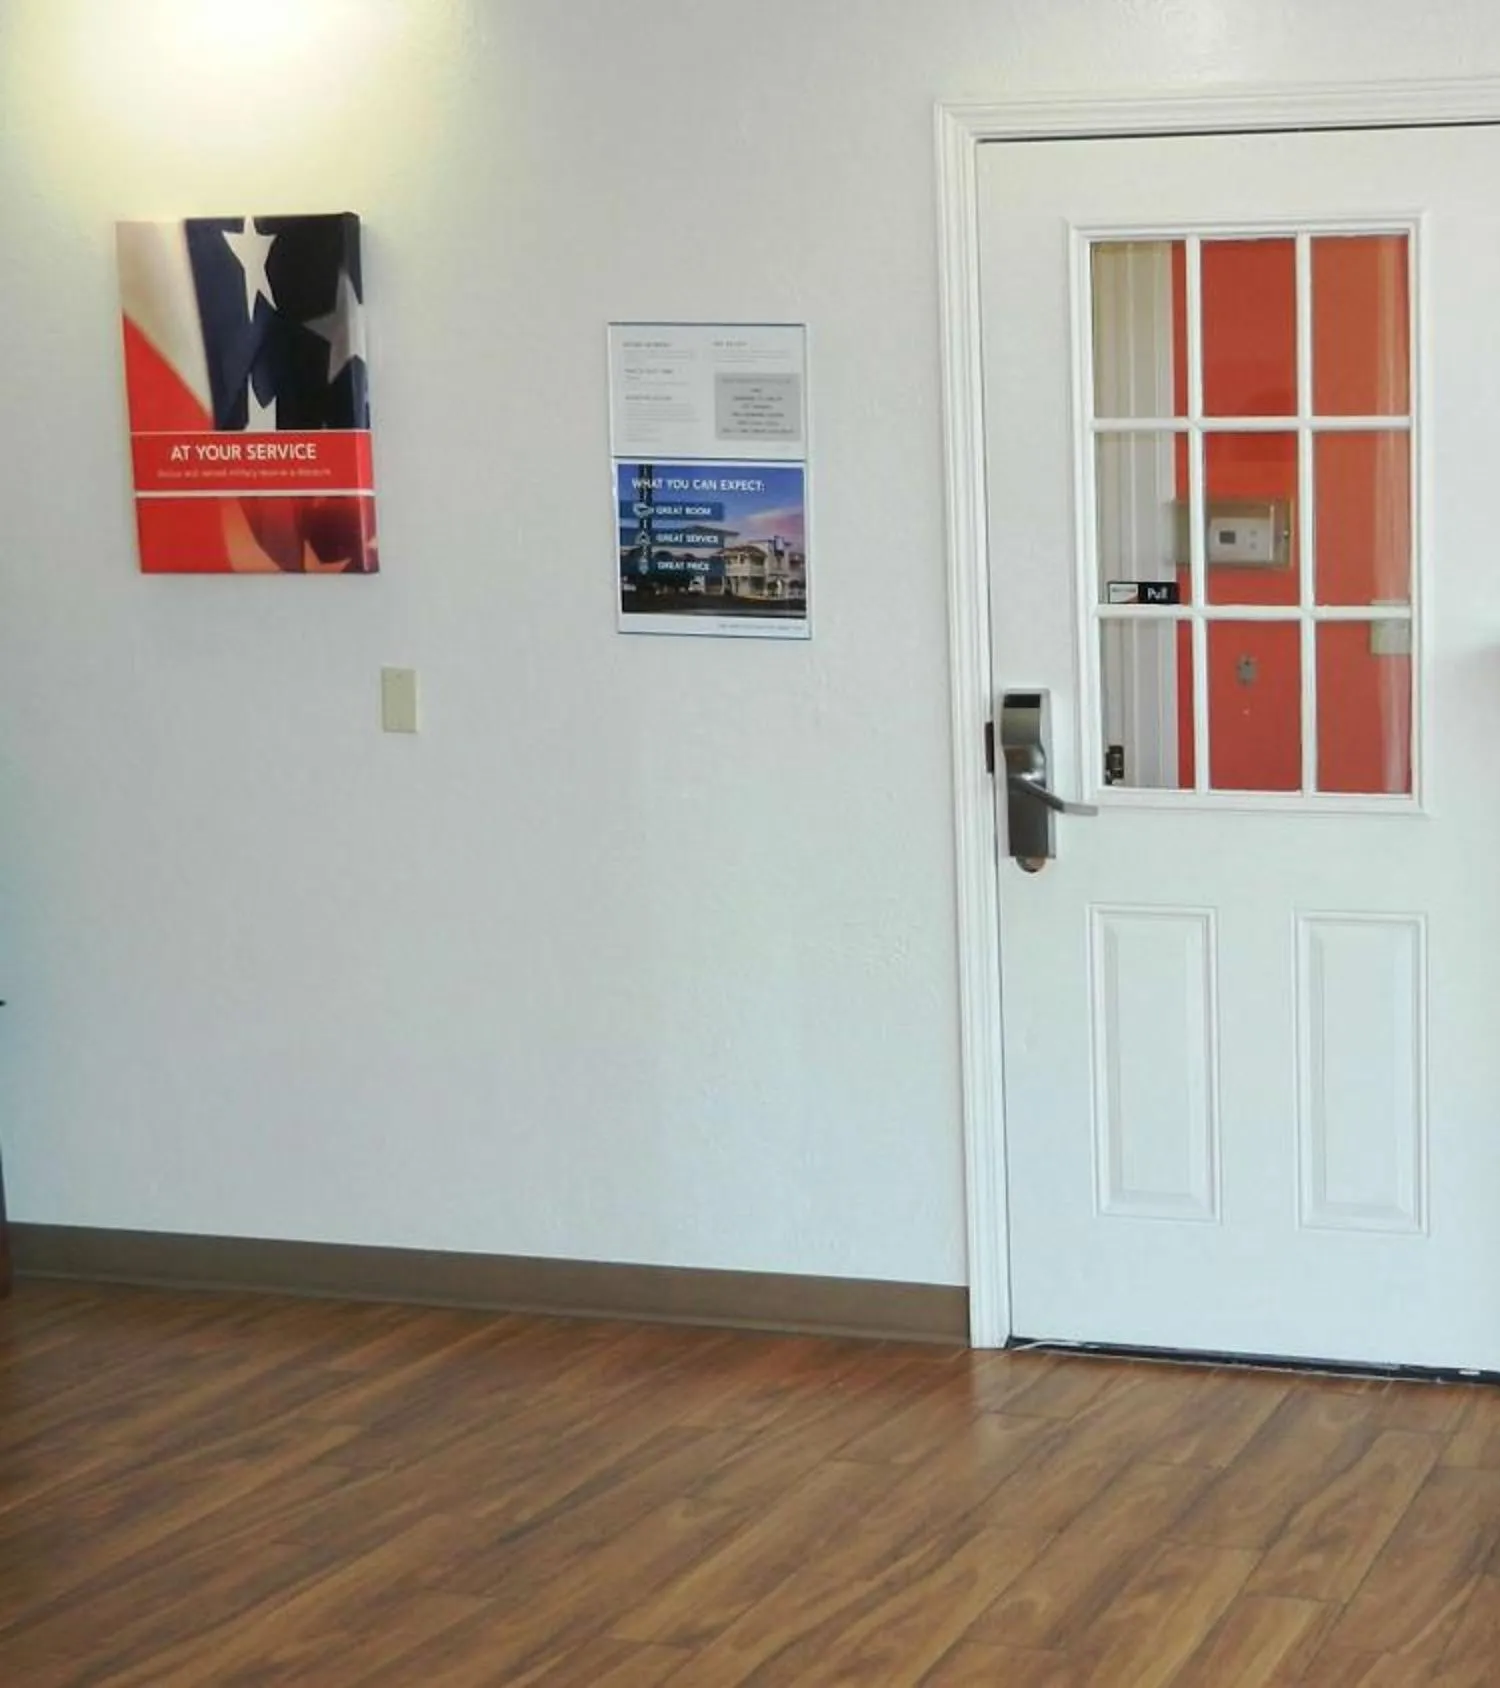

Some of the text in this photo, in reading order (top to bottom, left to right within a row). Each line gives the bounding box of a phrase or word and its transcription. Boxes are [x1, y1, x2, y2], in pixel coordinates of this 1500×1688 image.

[171, 443, 317, 462] AT YOUR SERVICE
[631, 478, 766, 493] WHAT YOU CAN EXPECT:
[655, 506, 712, 516] GREAT ROOM
[655, 533, 720, 544] GREAT SERVICE
[656, 561, 711, 572] GREAT PRICE
[1147, 587, 1168, 600] Pull
